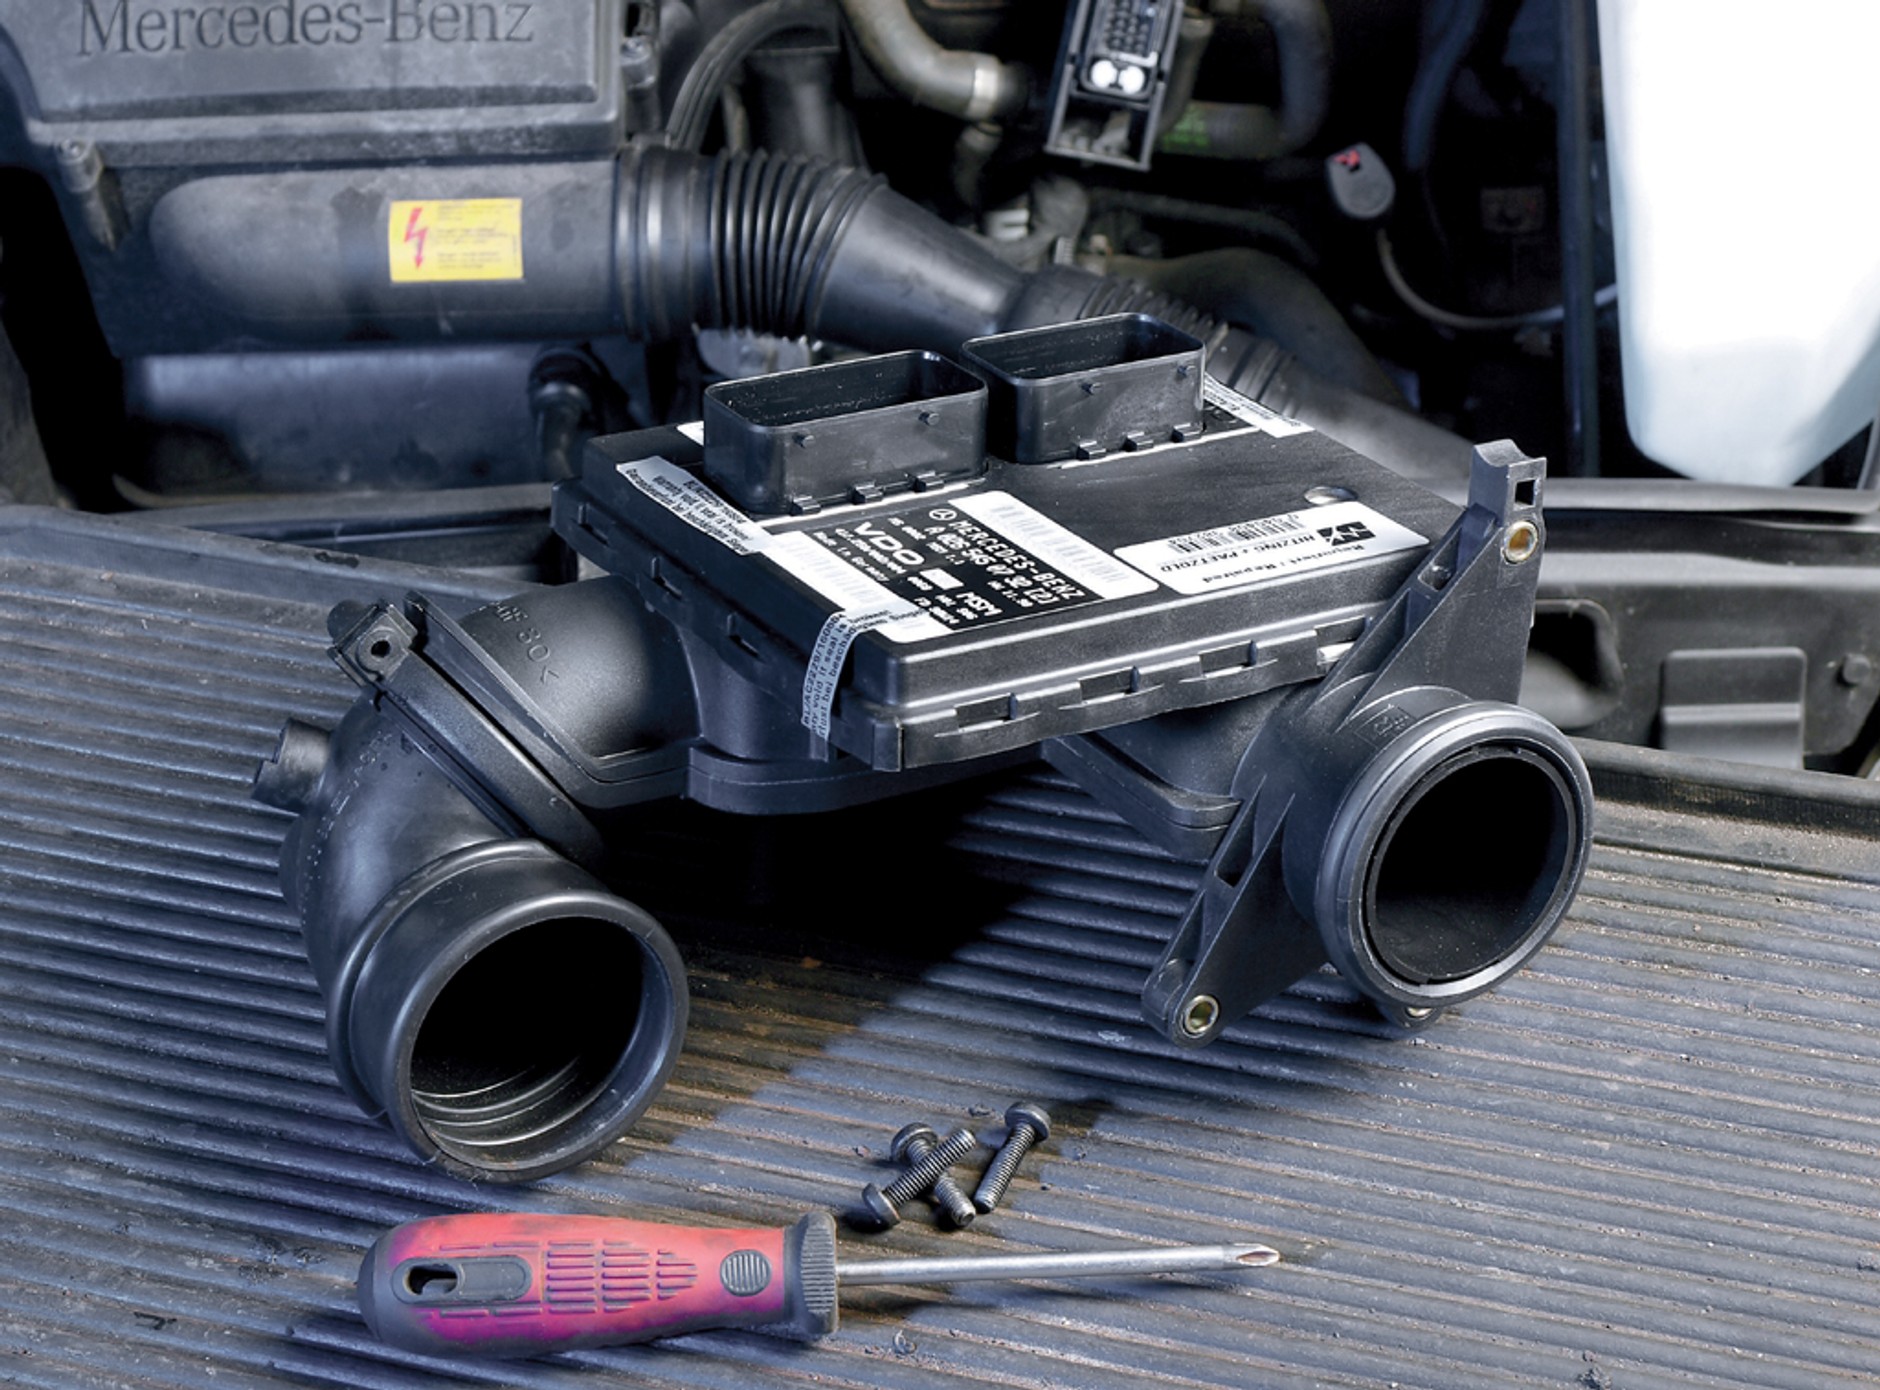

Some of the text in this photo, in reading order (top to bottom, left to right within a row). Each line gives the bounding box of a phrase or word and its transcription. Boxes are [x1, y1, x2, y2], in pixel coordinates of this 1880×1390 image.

[77, 0, 534, 56] Mercedes-Benz
[854, 521, 925, 566] VDO
[1254, 533, 1315, 554] HITZING
[949, 520, 1086, 600] MERCEDES-BENZ
[955, 591, 1003, 616] MSM
[825, 636, 839, 663] seal
[822, 681, 833, 702] bei
